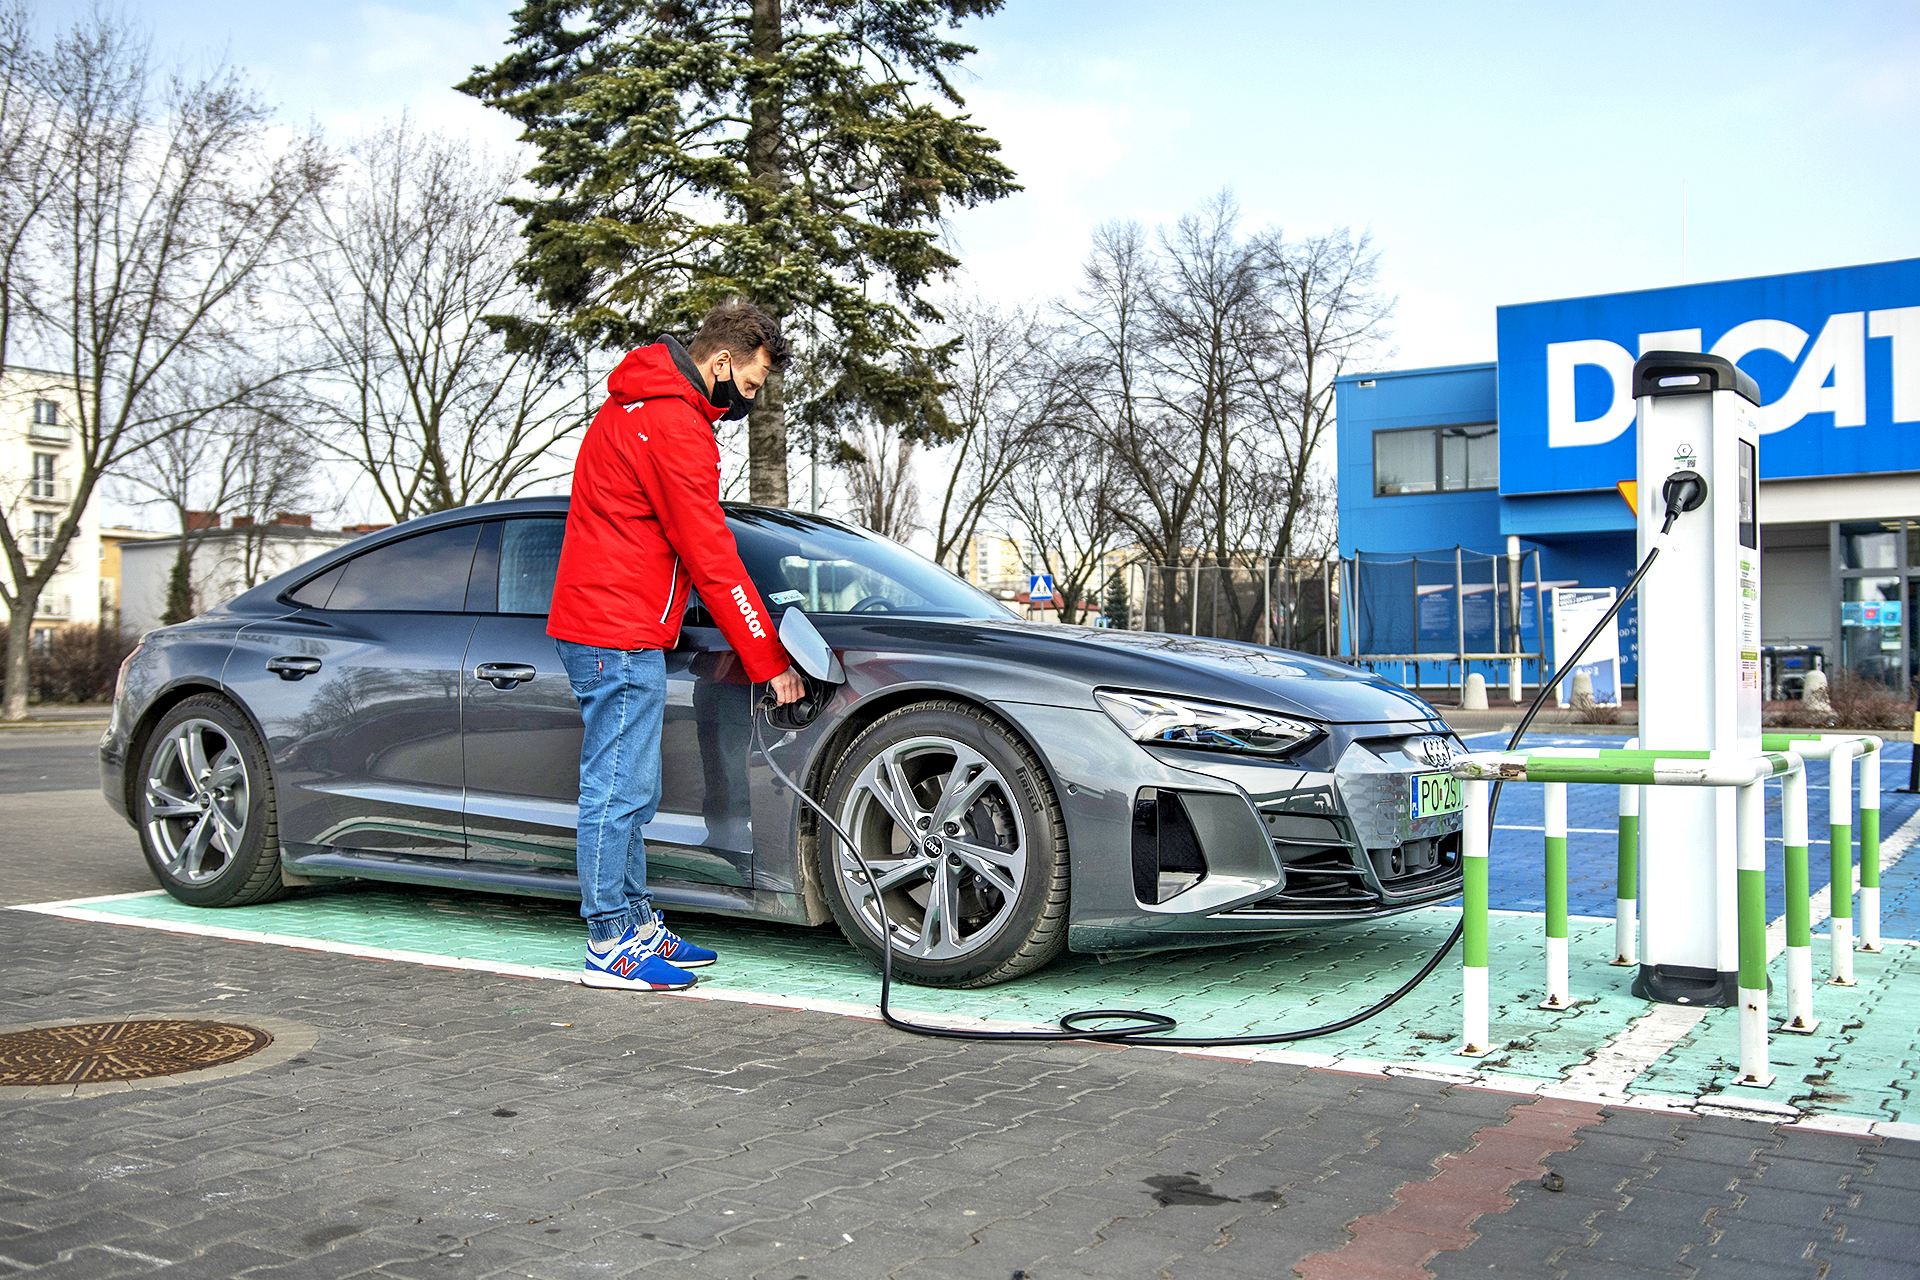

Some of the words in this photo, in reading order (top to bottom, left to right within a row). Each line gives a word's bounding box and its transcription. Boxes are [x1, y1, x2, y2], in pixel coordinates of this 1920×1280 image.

[731, 585, 767, 639] motor
[1015, 766, 1044, 814] PIRELLI
[1422, 779, 1439, 812] PO
[1443, 777, 1463, 810] 2SJ
[656, 939, 679, 958] N
[612, 956, 639, 977] N
